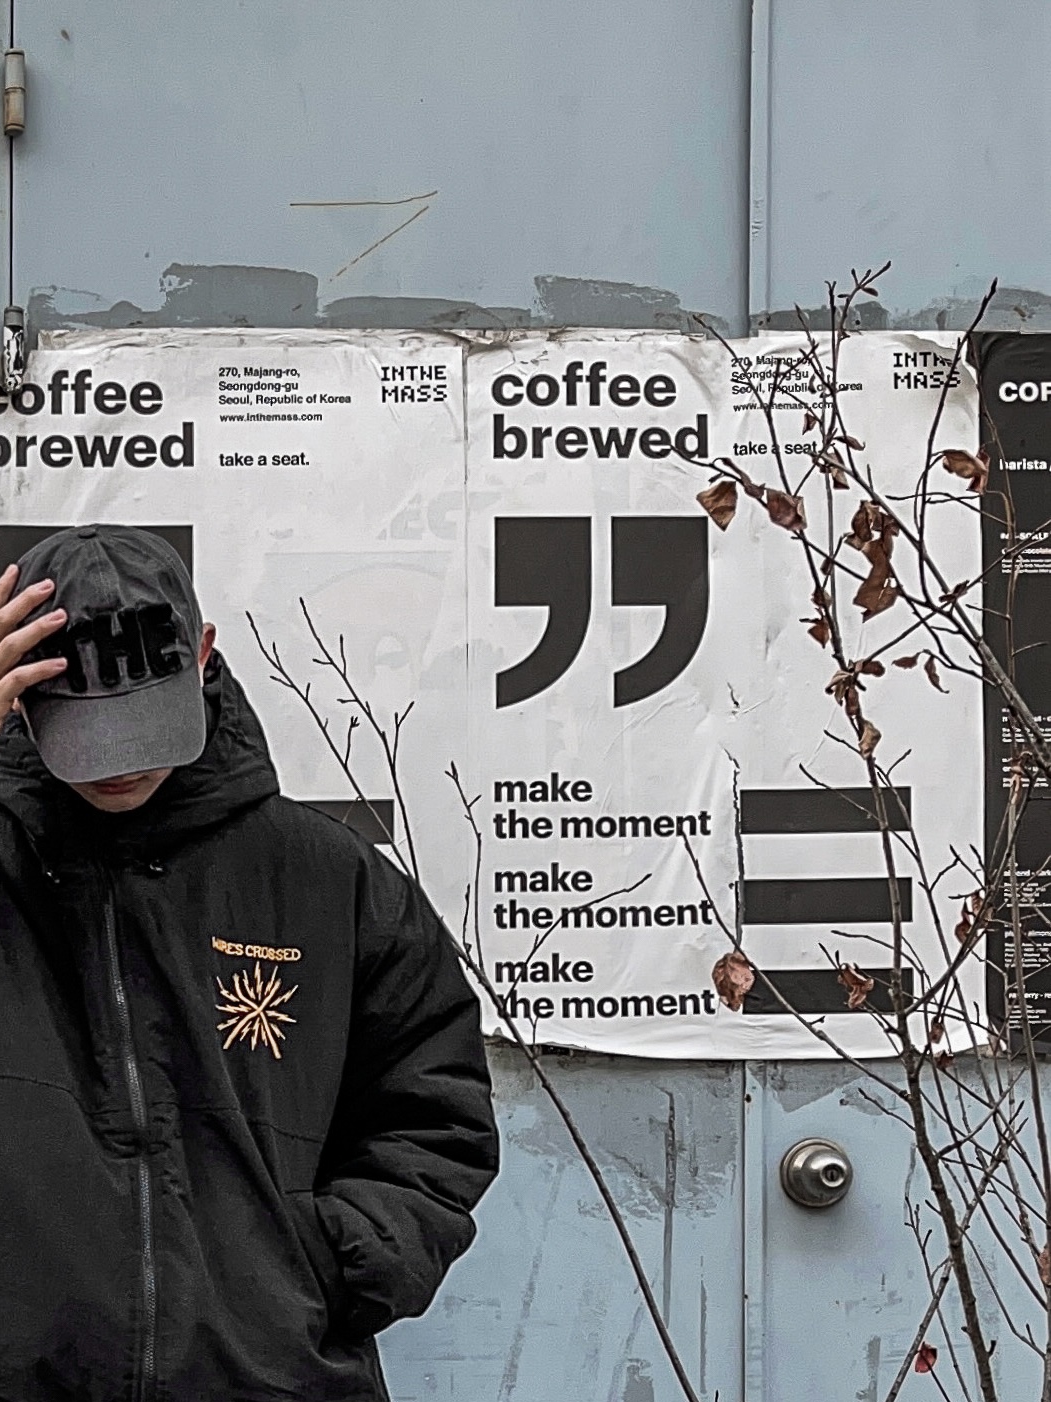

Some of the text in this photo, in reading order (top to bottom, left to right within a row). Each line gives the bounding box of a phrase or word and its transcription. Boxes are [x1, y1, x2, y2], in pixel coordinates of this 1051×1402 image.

[218, 366, 301, 379] 270, Majang-ro,
[491, 361, 677, 407] coffee
[893, 371, 961, 389] MASS
[218, 381, 299, 392] Seongdong-gu
[381, 385, 448, 403] MASS
[218, 394, 351, 406] Seoul, Republic of Korea
[220, 413, 323, 422] www.inthemass.com
[493, 414, 708, 459] brewed
[219, 452, 310, 467] take a seat.
[733, 442, 768, 456] take
[785, 441, 818, 455] seat
[494, 772, 593, 802] make
[493, 809, 711, 839] the moment
[494, 862, 593, 893] make
[493, 899, 713, 929] the moment
[495, 953, 594, 983] make
[562, 990, 716, 1018] moment
